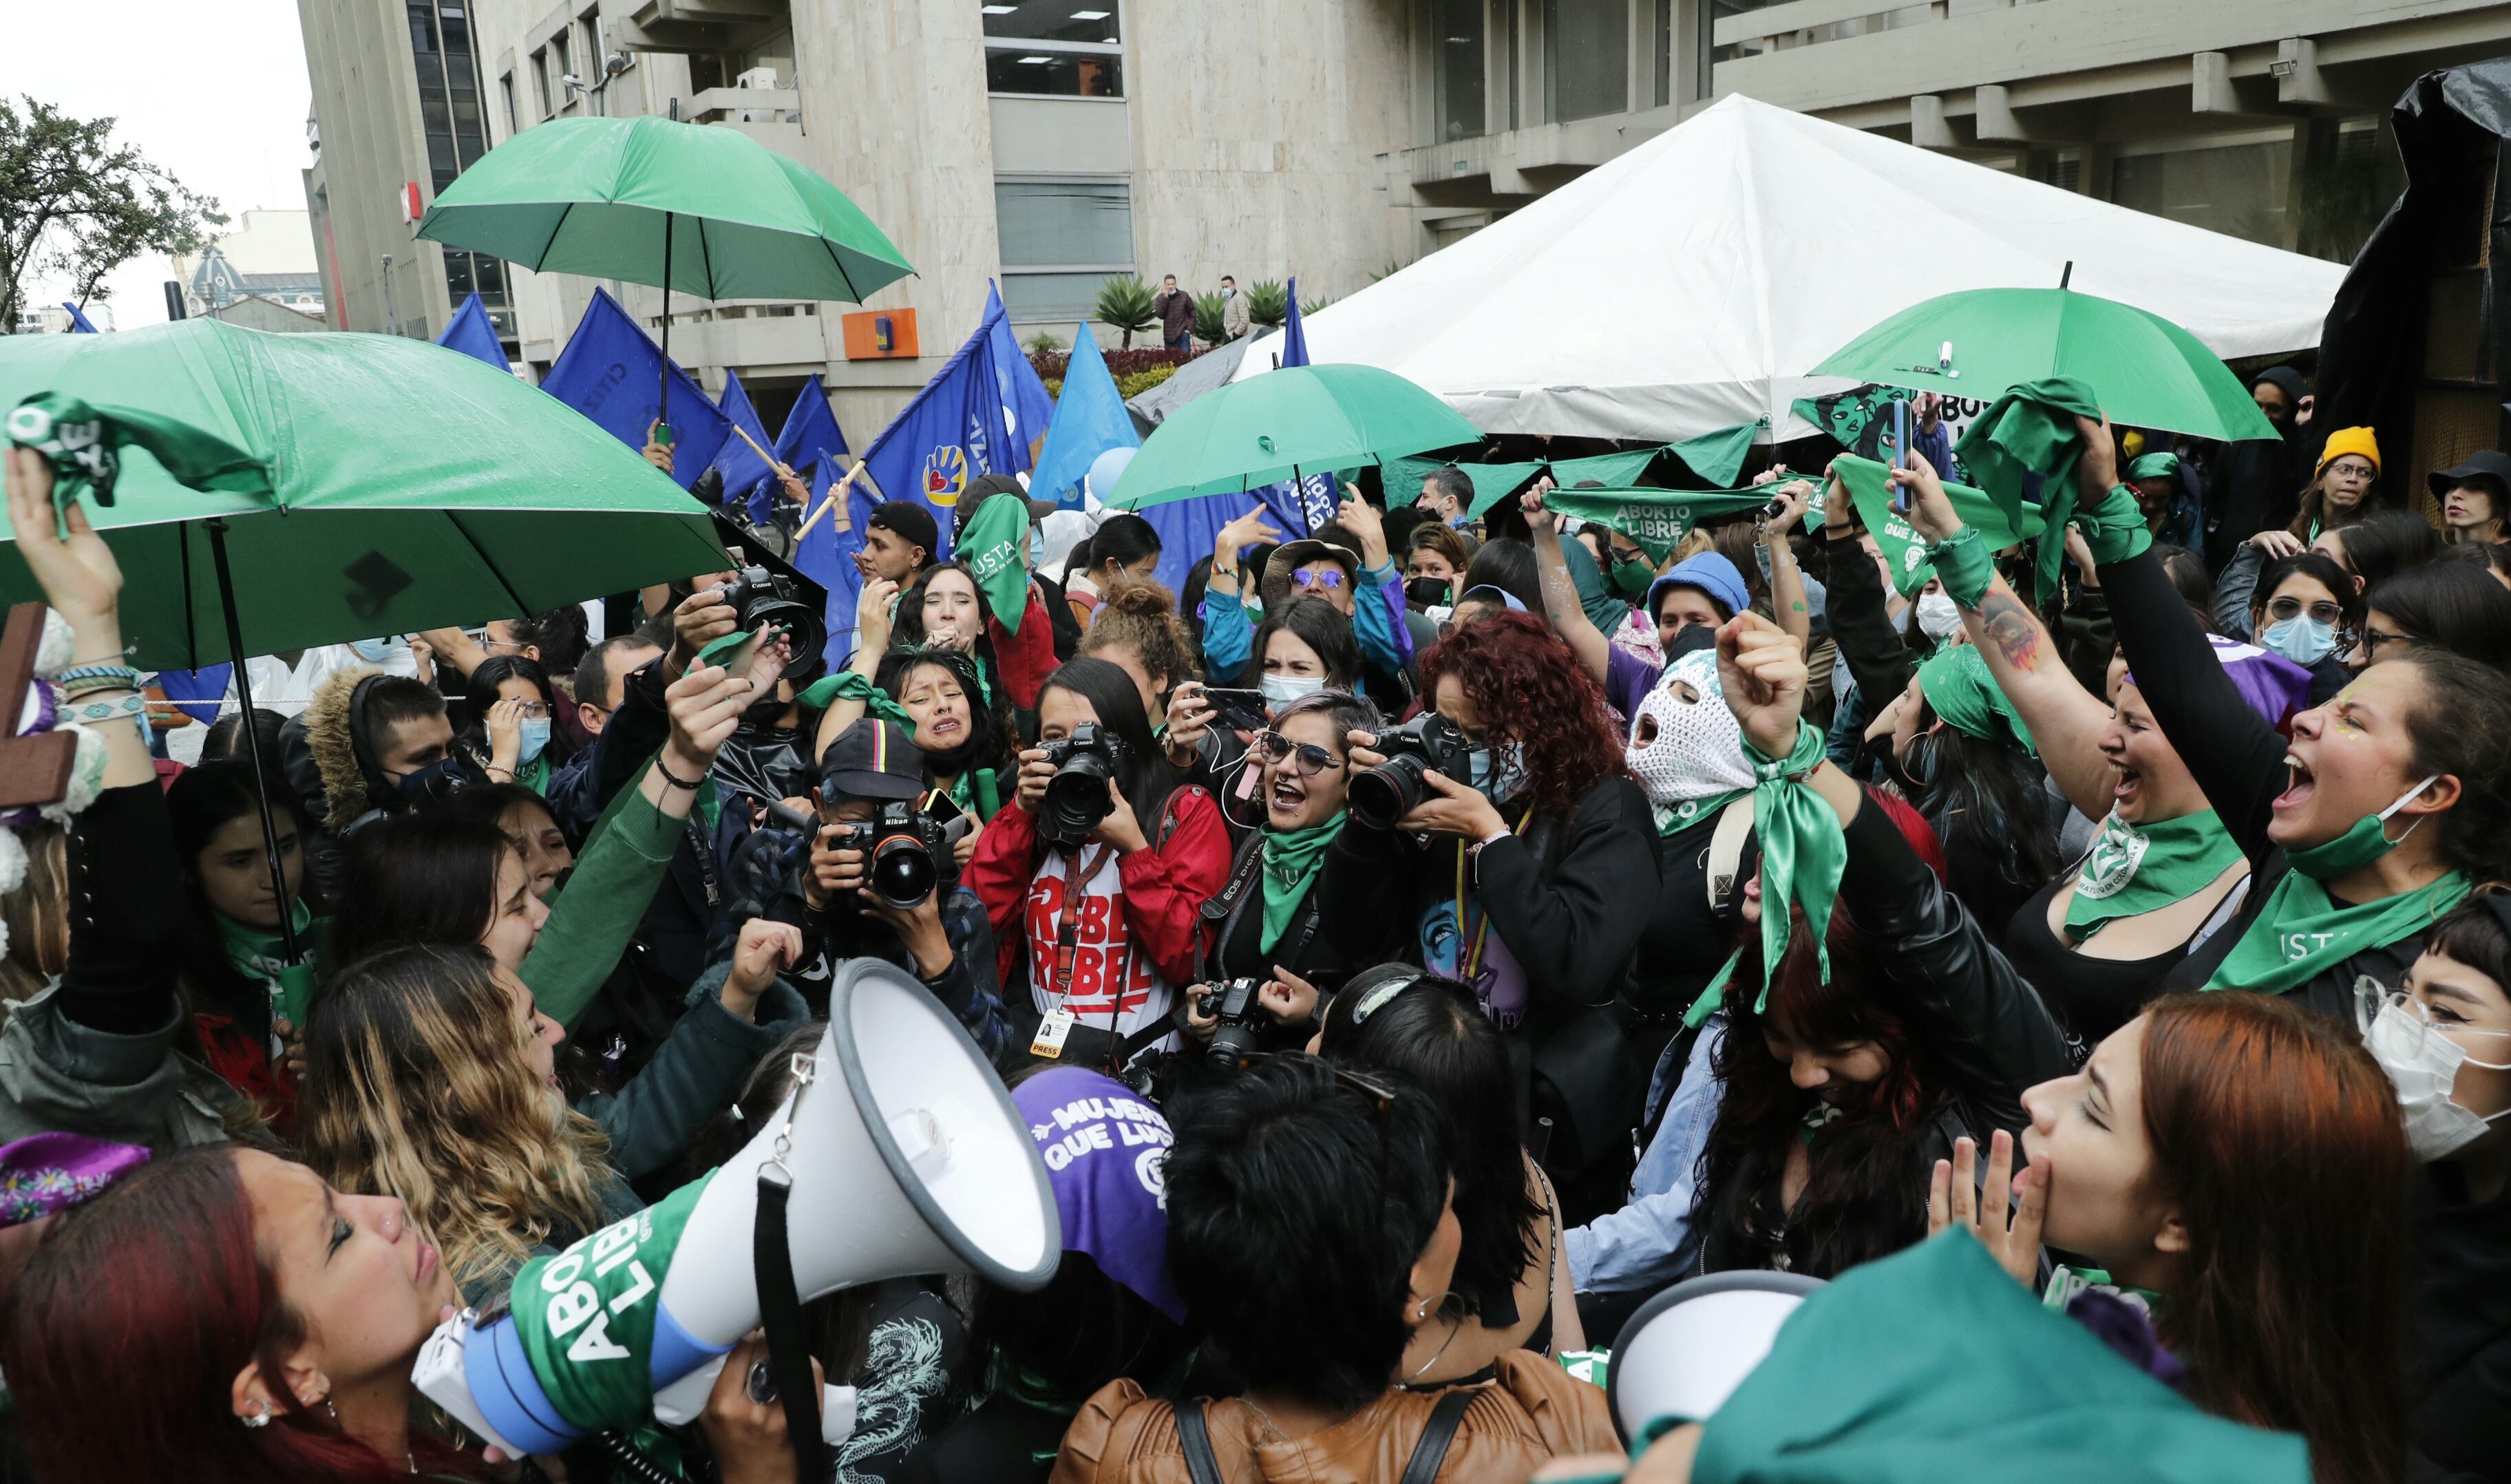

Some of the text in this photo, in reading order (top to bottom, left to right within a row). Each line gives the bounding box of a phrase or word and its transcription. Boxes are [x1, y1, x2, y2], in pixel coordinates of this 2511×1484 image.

[1614, 504, 1690, 521] ABORTO
[1627, 520, 1683, 538] LIBRE
[1884, 522, 1911, 540] QUE
[1400, 735, 1419, 743] Canon
[1223, 840, 1264, 901] EOS DIGITA
[1033, 1044, 1058, 1056] PRESS
[1044, 1123, 1114, 1171] QUE
[592, 1217, 656, 1315] LIB
[540, 1237, 631, 1361] ABO
